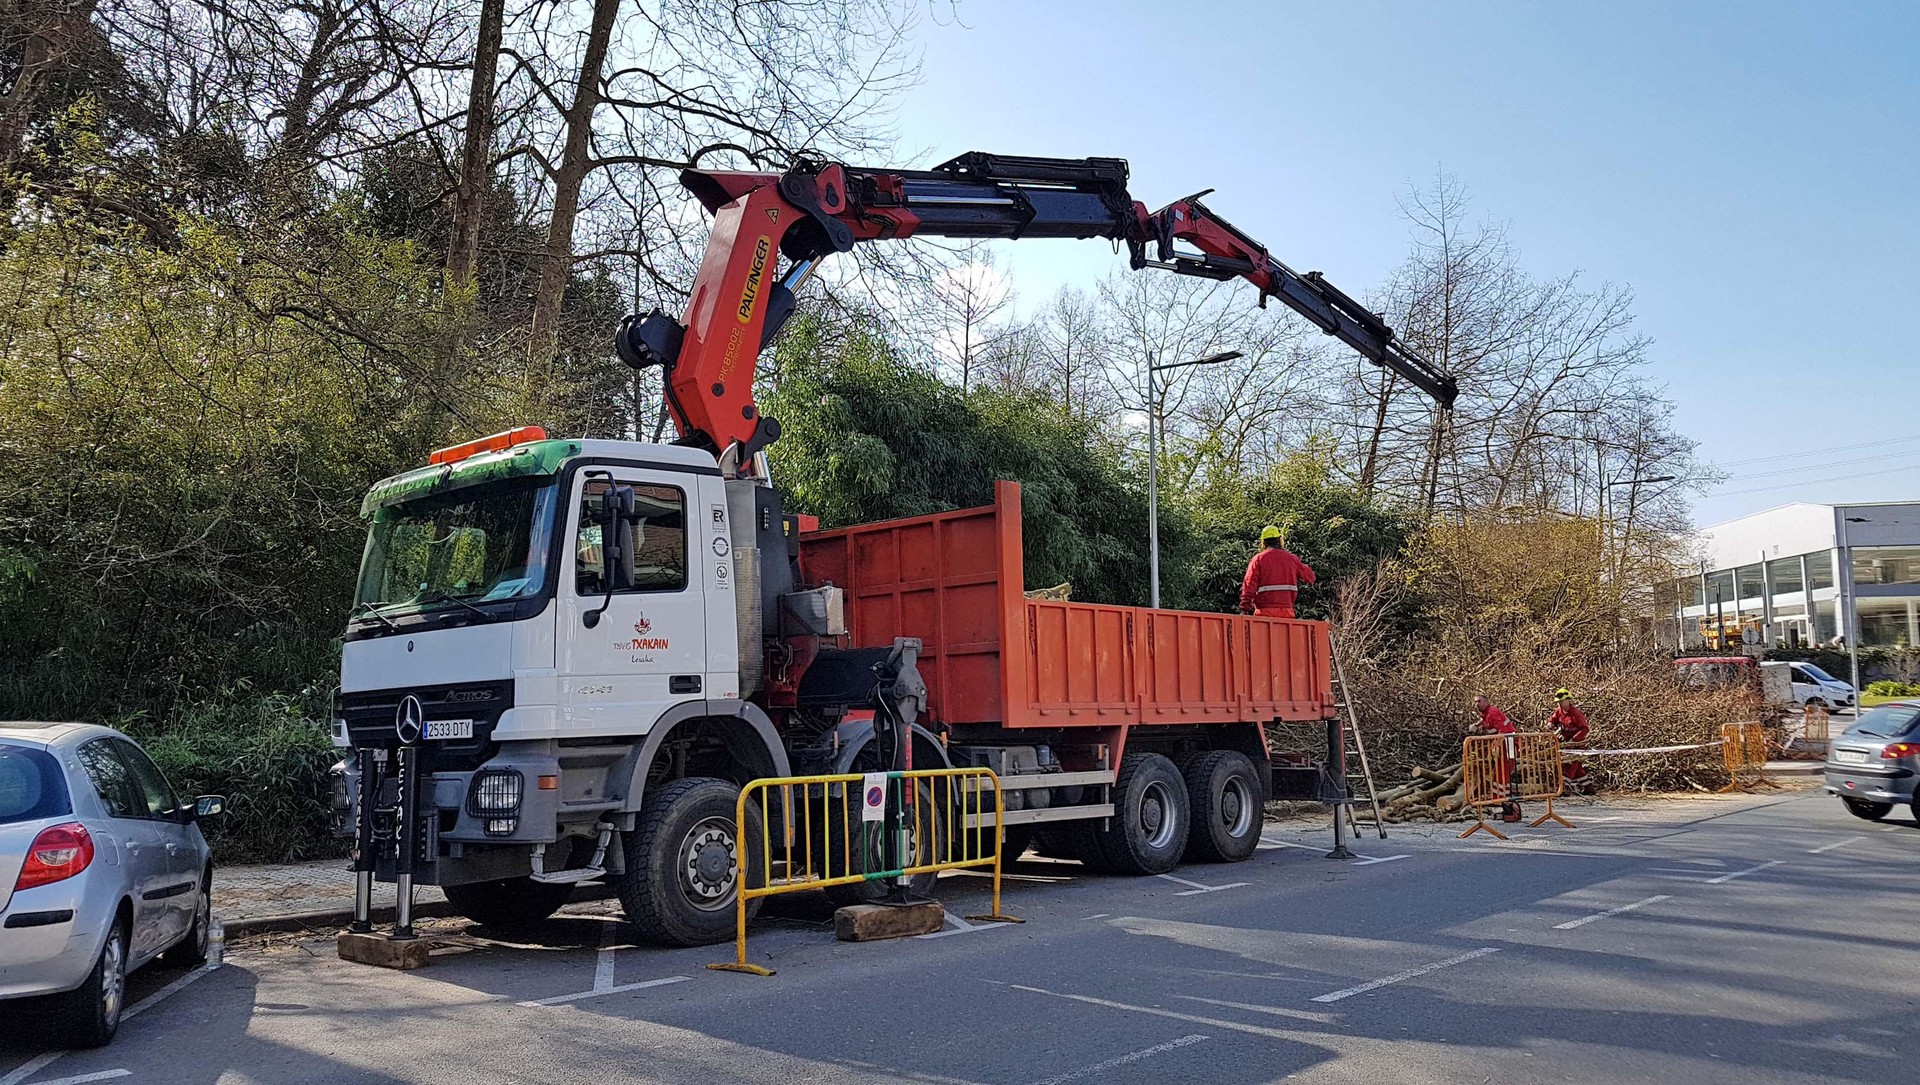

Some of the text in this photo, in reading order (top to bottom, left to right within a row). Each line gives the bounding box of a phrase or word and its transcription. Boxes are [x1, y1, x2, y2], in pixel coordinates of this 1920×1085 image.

[739, 238, 769, 319] PALFINGER
[718, 327, 741, 383] PK 85002
[631, 638, 669, 650] TXAKAIN
[428, 721, 471, 737] 2533 DTY
[395, 750, 405, 860] LESAKA
